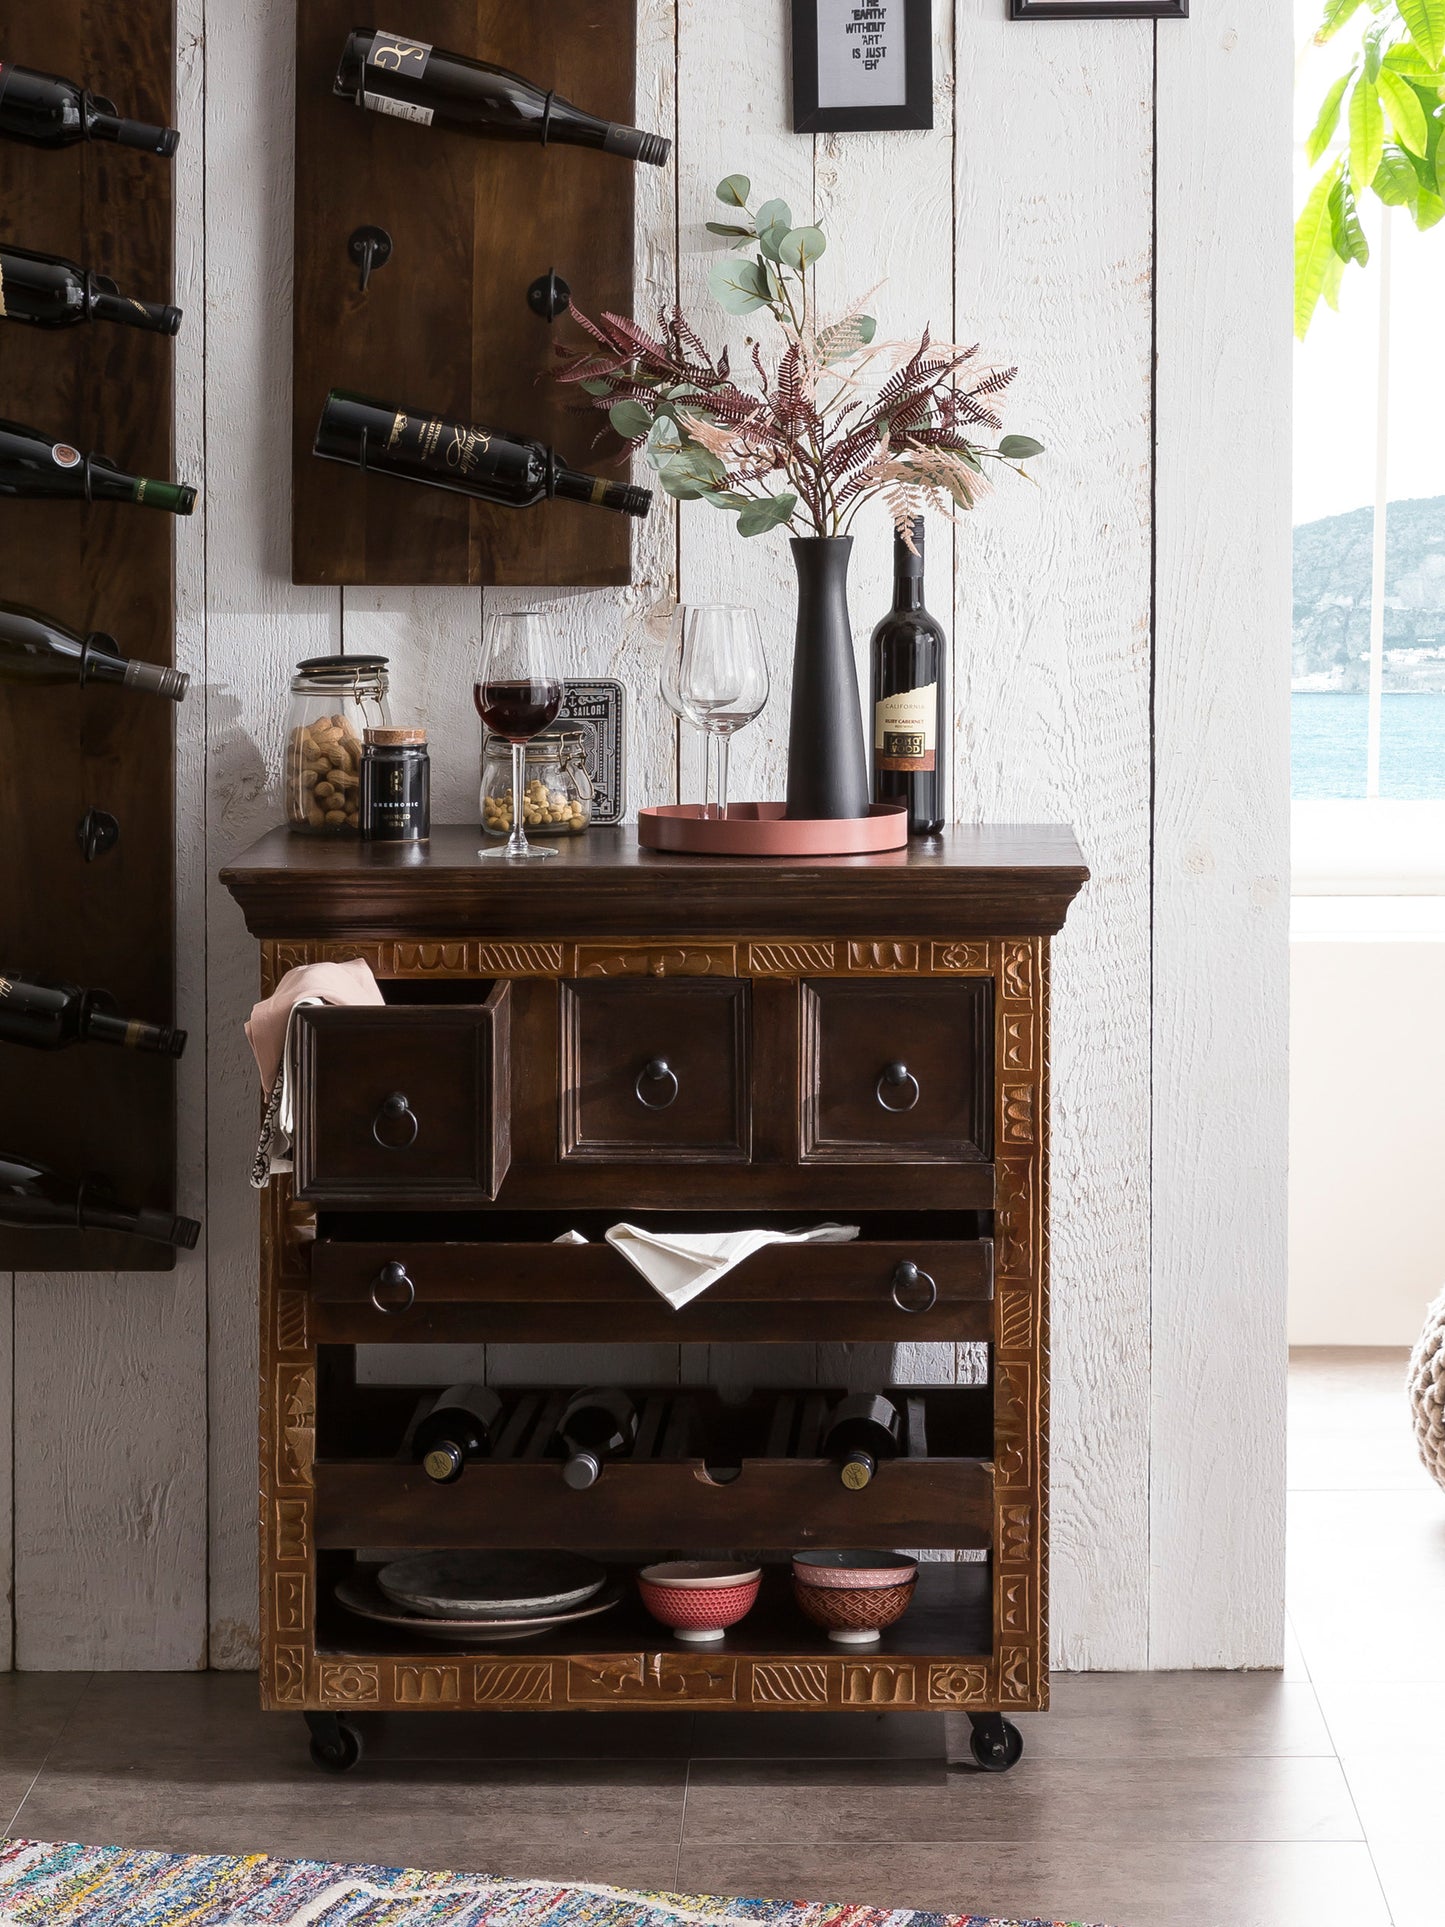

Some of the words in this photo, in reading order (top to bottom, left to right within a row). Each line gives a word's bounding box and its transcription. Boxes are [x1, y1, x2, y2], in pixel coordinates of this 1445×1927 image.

[845, 22, 886, 34] WITHOUT
[852, 48, 861, 59] IS
[865, 46, 887, 58] JUST
[573, 704, 605, 717] SAILOR!
